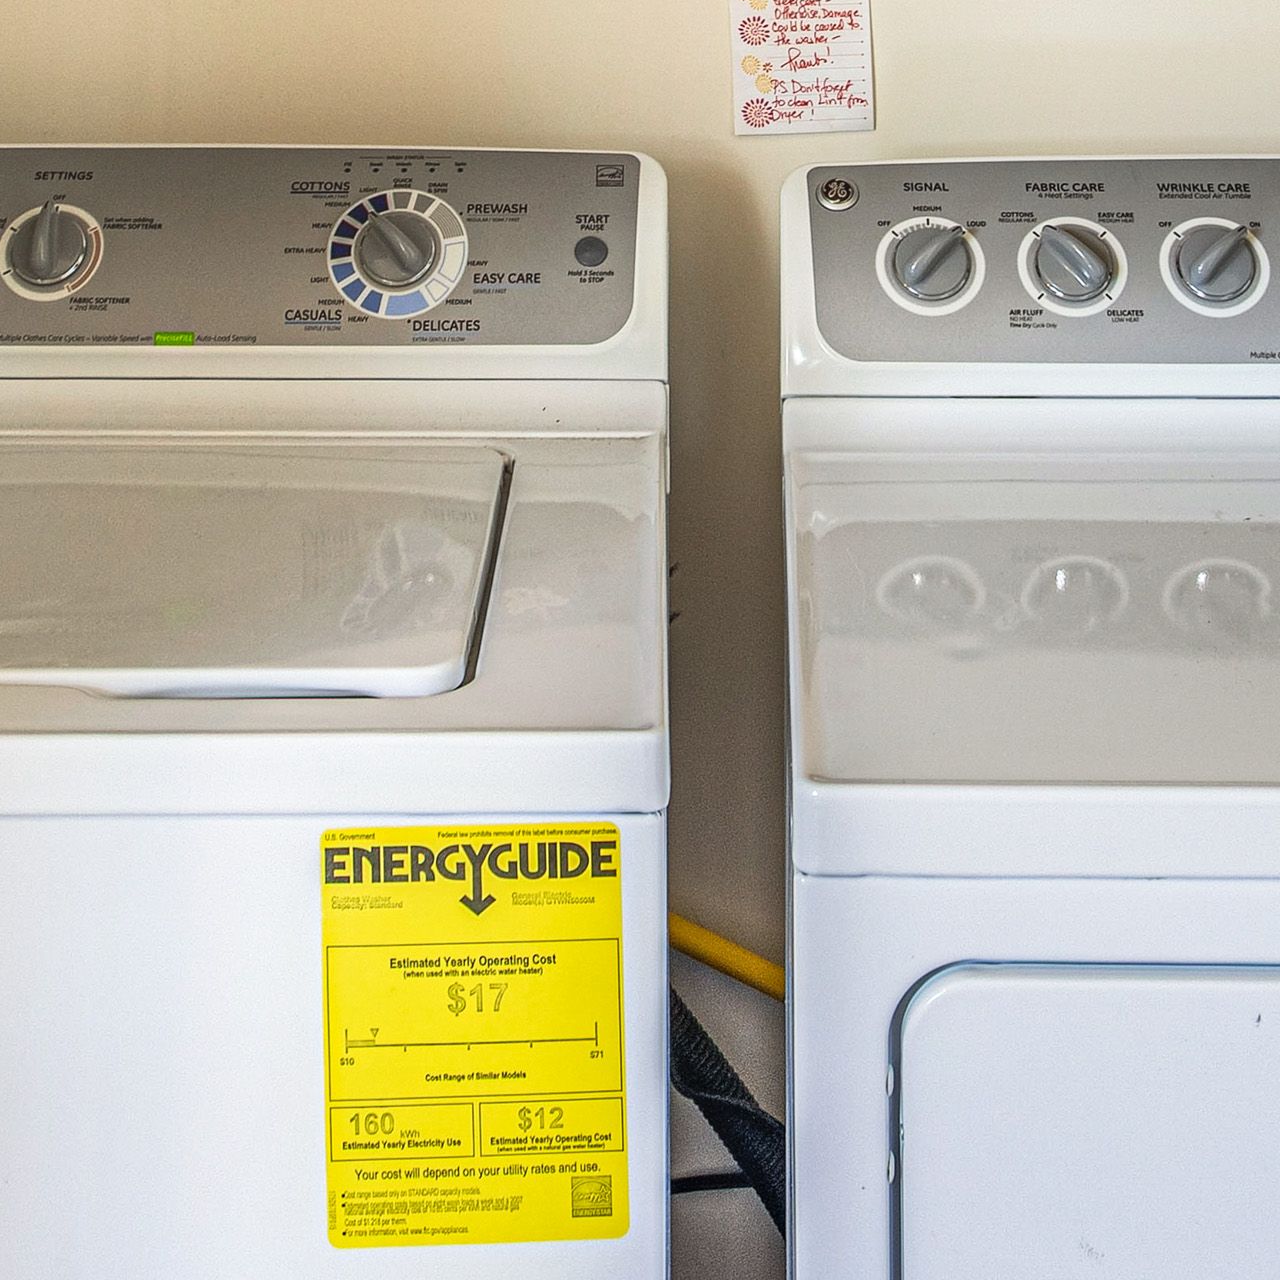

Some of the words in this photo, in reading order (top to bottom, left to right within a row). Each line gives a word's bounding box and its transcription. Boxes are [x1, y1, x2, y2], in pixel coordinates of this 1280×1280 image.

[800, 20, 811, 32] be
[814, 19, 845, 32] caused
[773, 32, 791, 46] the
[795, 32, 829, 45] washer
[820, 77, 854, 99] forget
[772, 95, 786, 108] to
[787, 95, 814, 107] clean
[33, 170, 94, 181] SETTINGS
[291, 181, 351, 192] COTTONS
[903, 182, 949, 192] SIGNAL
[1025, 183, 1069, 193] FABRIC
[1072, 183, 1105, 193] CARE
[1157, 183, 1215, 193] WRINKLE
[1217, 183, 1251, 193] CARE
[466, 203, 528, 214] PREWASH
[575, 214, 610, 224] START
[473, 272, 506, 284] EASY
[507, 272, 541, 284] CARE
[284, 309, 342, 321] CASUALS
[347, 315, 370, 323] HEAVY
[412, 320, 481, 332] DELICATES
[1250, 351, 1276, 359] Multiple
[324, 841, 617, 890] ENERGYGUIDE
[389, 956, 441, 969] Estimated
[443, 956, 476, 970] Yearly
[479, 954, 530, 968] Operating
[532, 954, 557, 965] Cost
[447, 982, 509, 1017] $17
[589, 1050, 604, 1059] $71
[339, 1057, 355, 1067] $10
[425, 1073, 442, 1082] Cost
[443, 1073, 466, 1083] Range
[467, 1072, 474, 1080] of
[475, 1071, 500, 1081] Similar
[501, 1071, 527, 1080] Models
[517, 1106, 565, 1132] $12
[348, 1112, 395, 1136] 160
[400, 1129, 421, 1139] kWh
[342, 1140, 380, 1150] Estimated
[382, 1139, 406, 1150] Yearly
[407, 1138, 445, 1149] Electricity
[446, 1138, 462, 1147] Use
[490, 1136, 528, 1146] Estimated
[530, 1135, 554, 1146] Yearly
[555, 1133, 593, 1144] Operating
[594, 1132, 612, 1142] Cost
[355, 1169, 379, 1181] Your
[381, 1168, 402, 1180] cost
[405, 1167, 421, 1179] will
[423, 1166, 460, 1181] depend
[462, 1167, 476, 1178] on
[478, 1167, 501, 1181] your
[502, 1164, 528, 1178] utility
[530, 1164, 556, 1176] rates
[559, 1162, 578, 1174] and
[579, 1162, 601, 1173] use.
